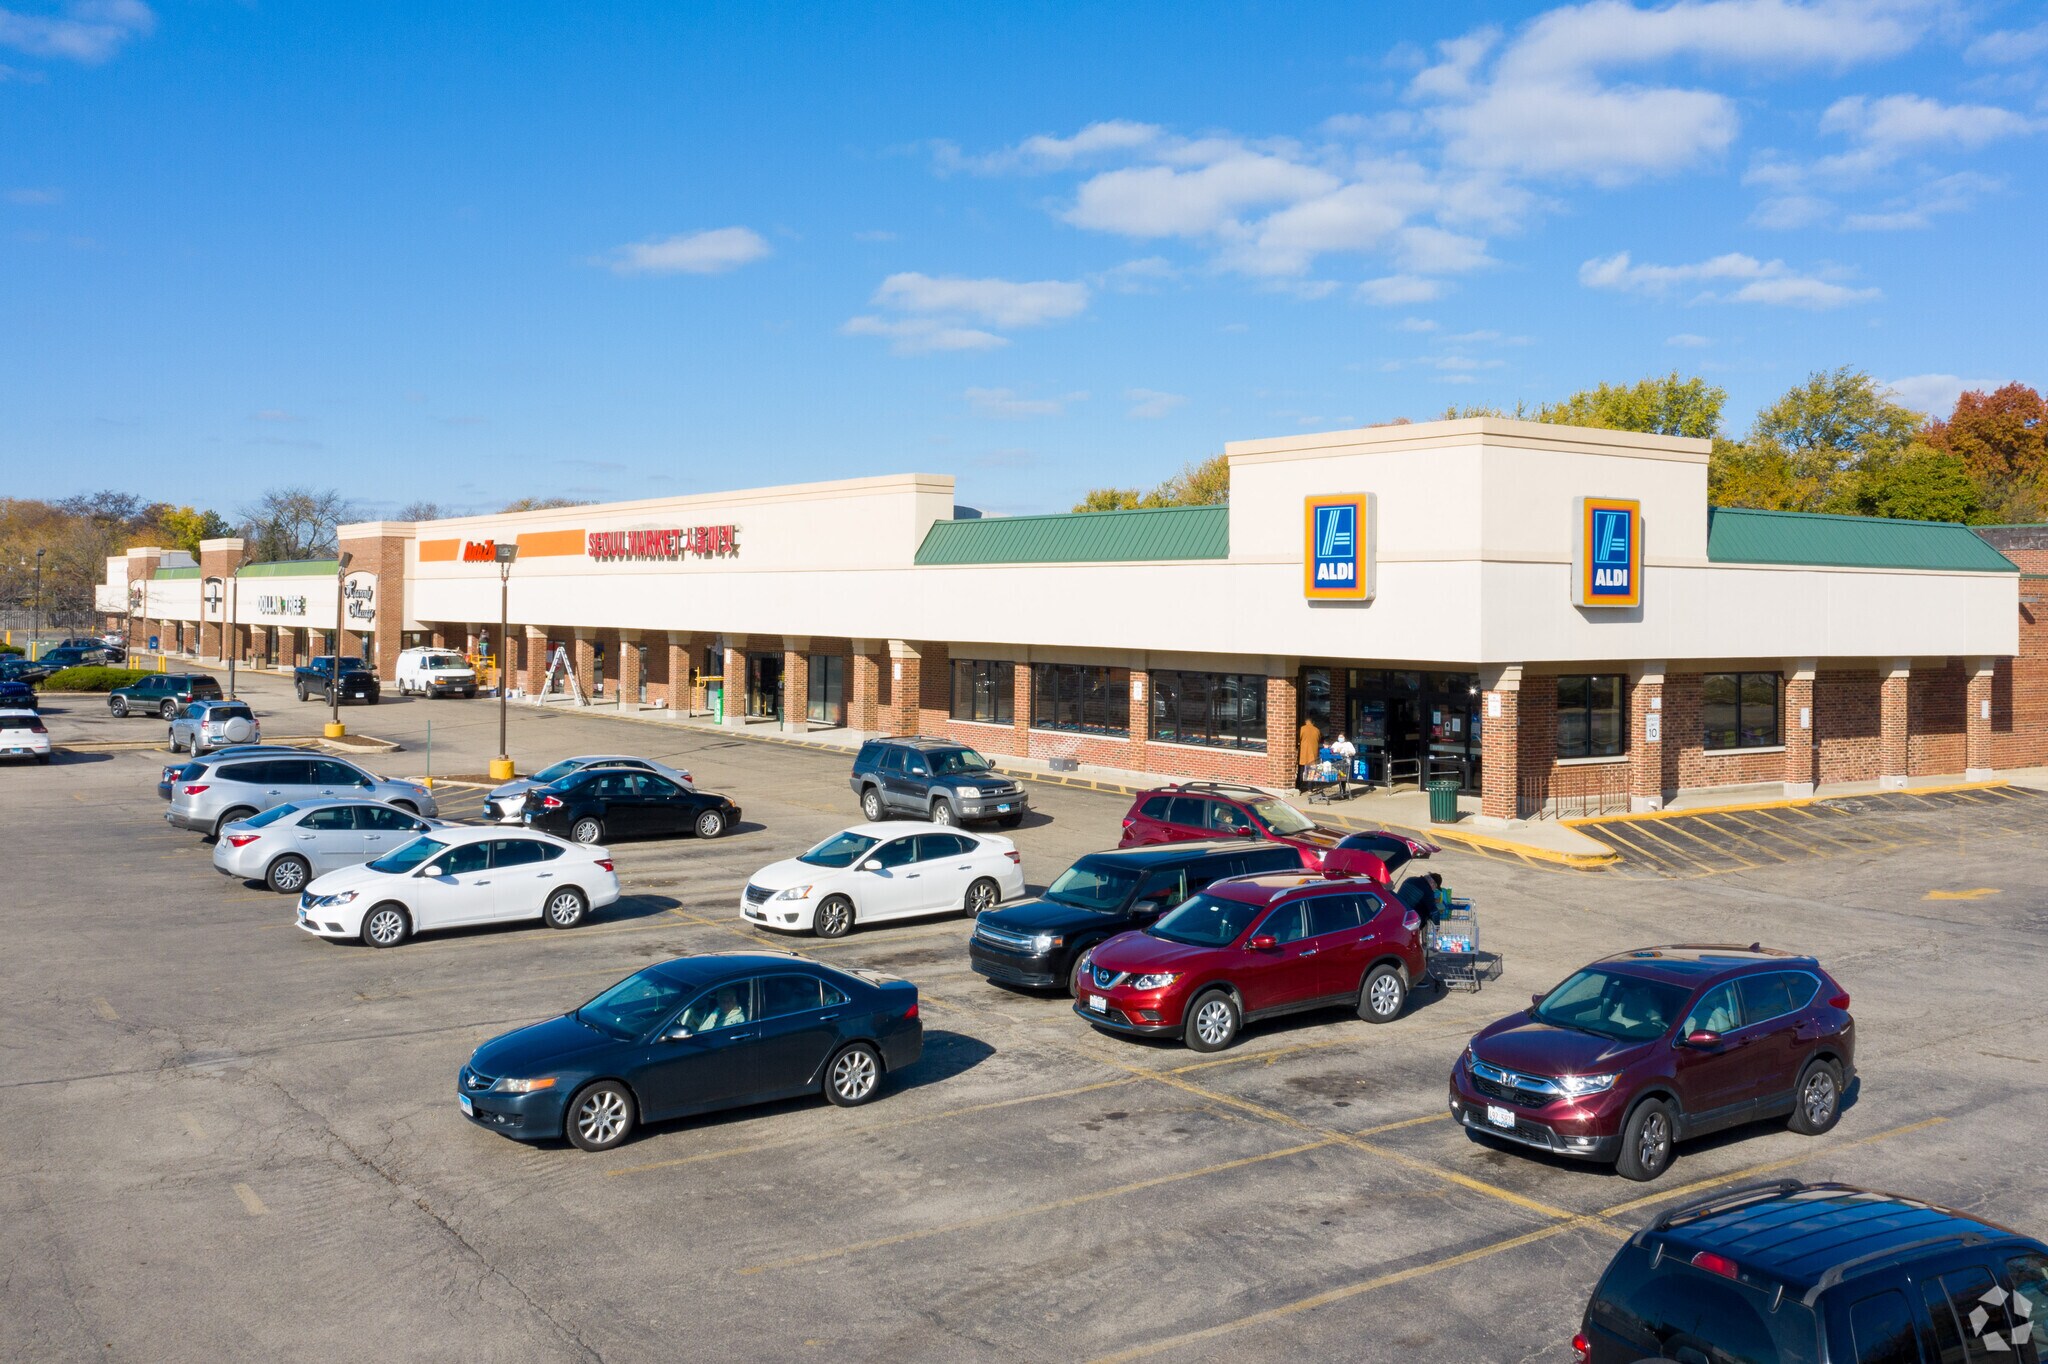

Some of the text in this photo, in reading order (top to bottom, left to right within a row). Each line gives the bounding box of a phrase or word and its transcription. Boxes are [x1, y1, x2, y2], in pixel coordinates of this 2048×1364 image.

[588, 529, 680, 557] SEOUL MARKET
[1317, 562, 1354, 581] ALDI
[1594, 568, 1628, 587] ALDI
[1649, 728, 1657, 738] 10
